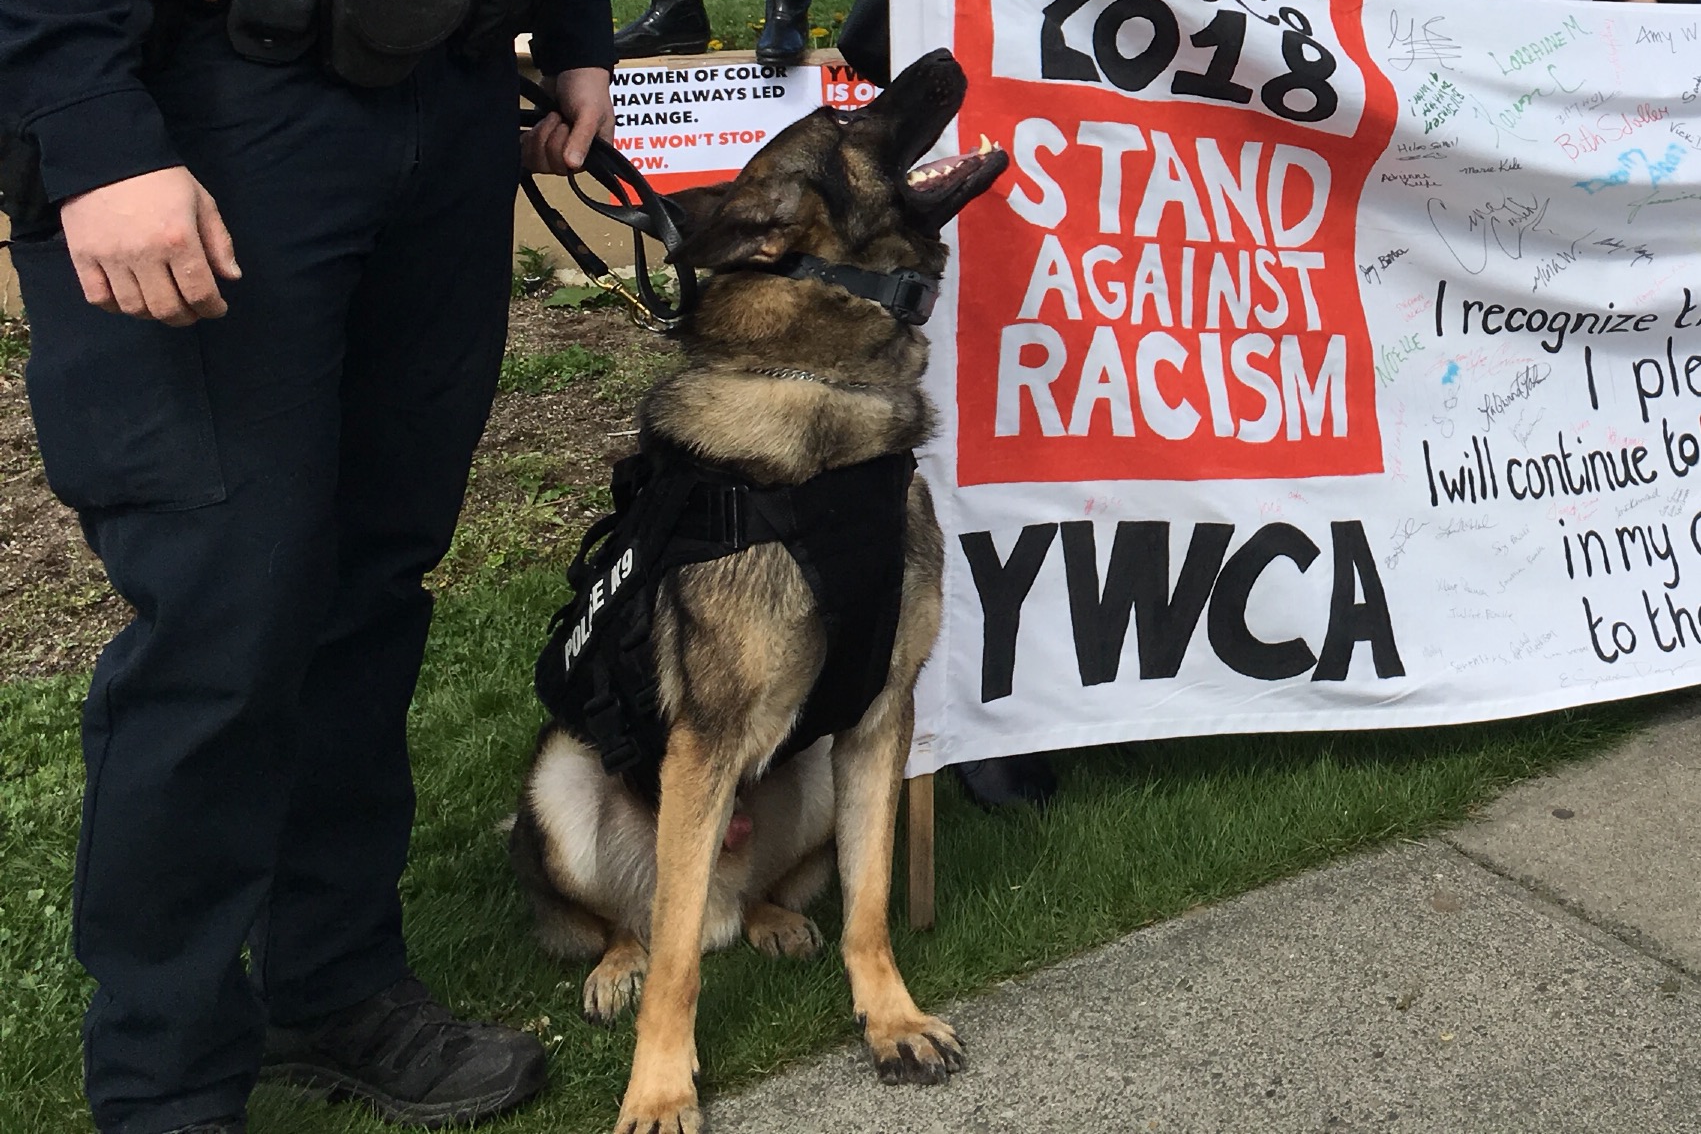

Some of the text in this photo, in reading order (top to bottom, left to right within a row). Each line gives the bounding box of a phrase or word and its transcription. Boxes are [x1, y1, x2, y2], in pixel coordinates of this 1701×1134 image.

[1635, 25, 1677, 54] Amy
[613, 66, 788, 86] WOMEN OF COLOR
[613, 85, 785, 107] HAVE ALWAYS LED
[826, 83, 849, 102] IS
[614, 111, 699, 127] CHANGE.
[614, 130, 766, 150] WE WON'T STOP
[629, 156, 669, 170] OW.
[1006, 118, 1333, 248] STAND
[1016, 233, 1326, 332] AGAINST
[1434, 280, 1447, 337] I
[1462, 298, 1659, 355] recognize
[1673, 287, 1701, 332] t
[995, 323, 1348, 444] RACISM
[1584, 345, 1599, 411] I
[1423, 439, 1438, 507] I
[1439, 435, 1499, 505] will
[1507, 430, 1659, 502] continue
[1662, 418, 1700, 478] to
[1558, 518, 1612, 581] in
[1615, 522, 1681, 589] my
[957, 520, 1407, 704] YWCA
[1582, 588, 1701, 664] to th
